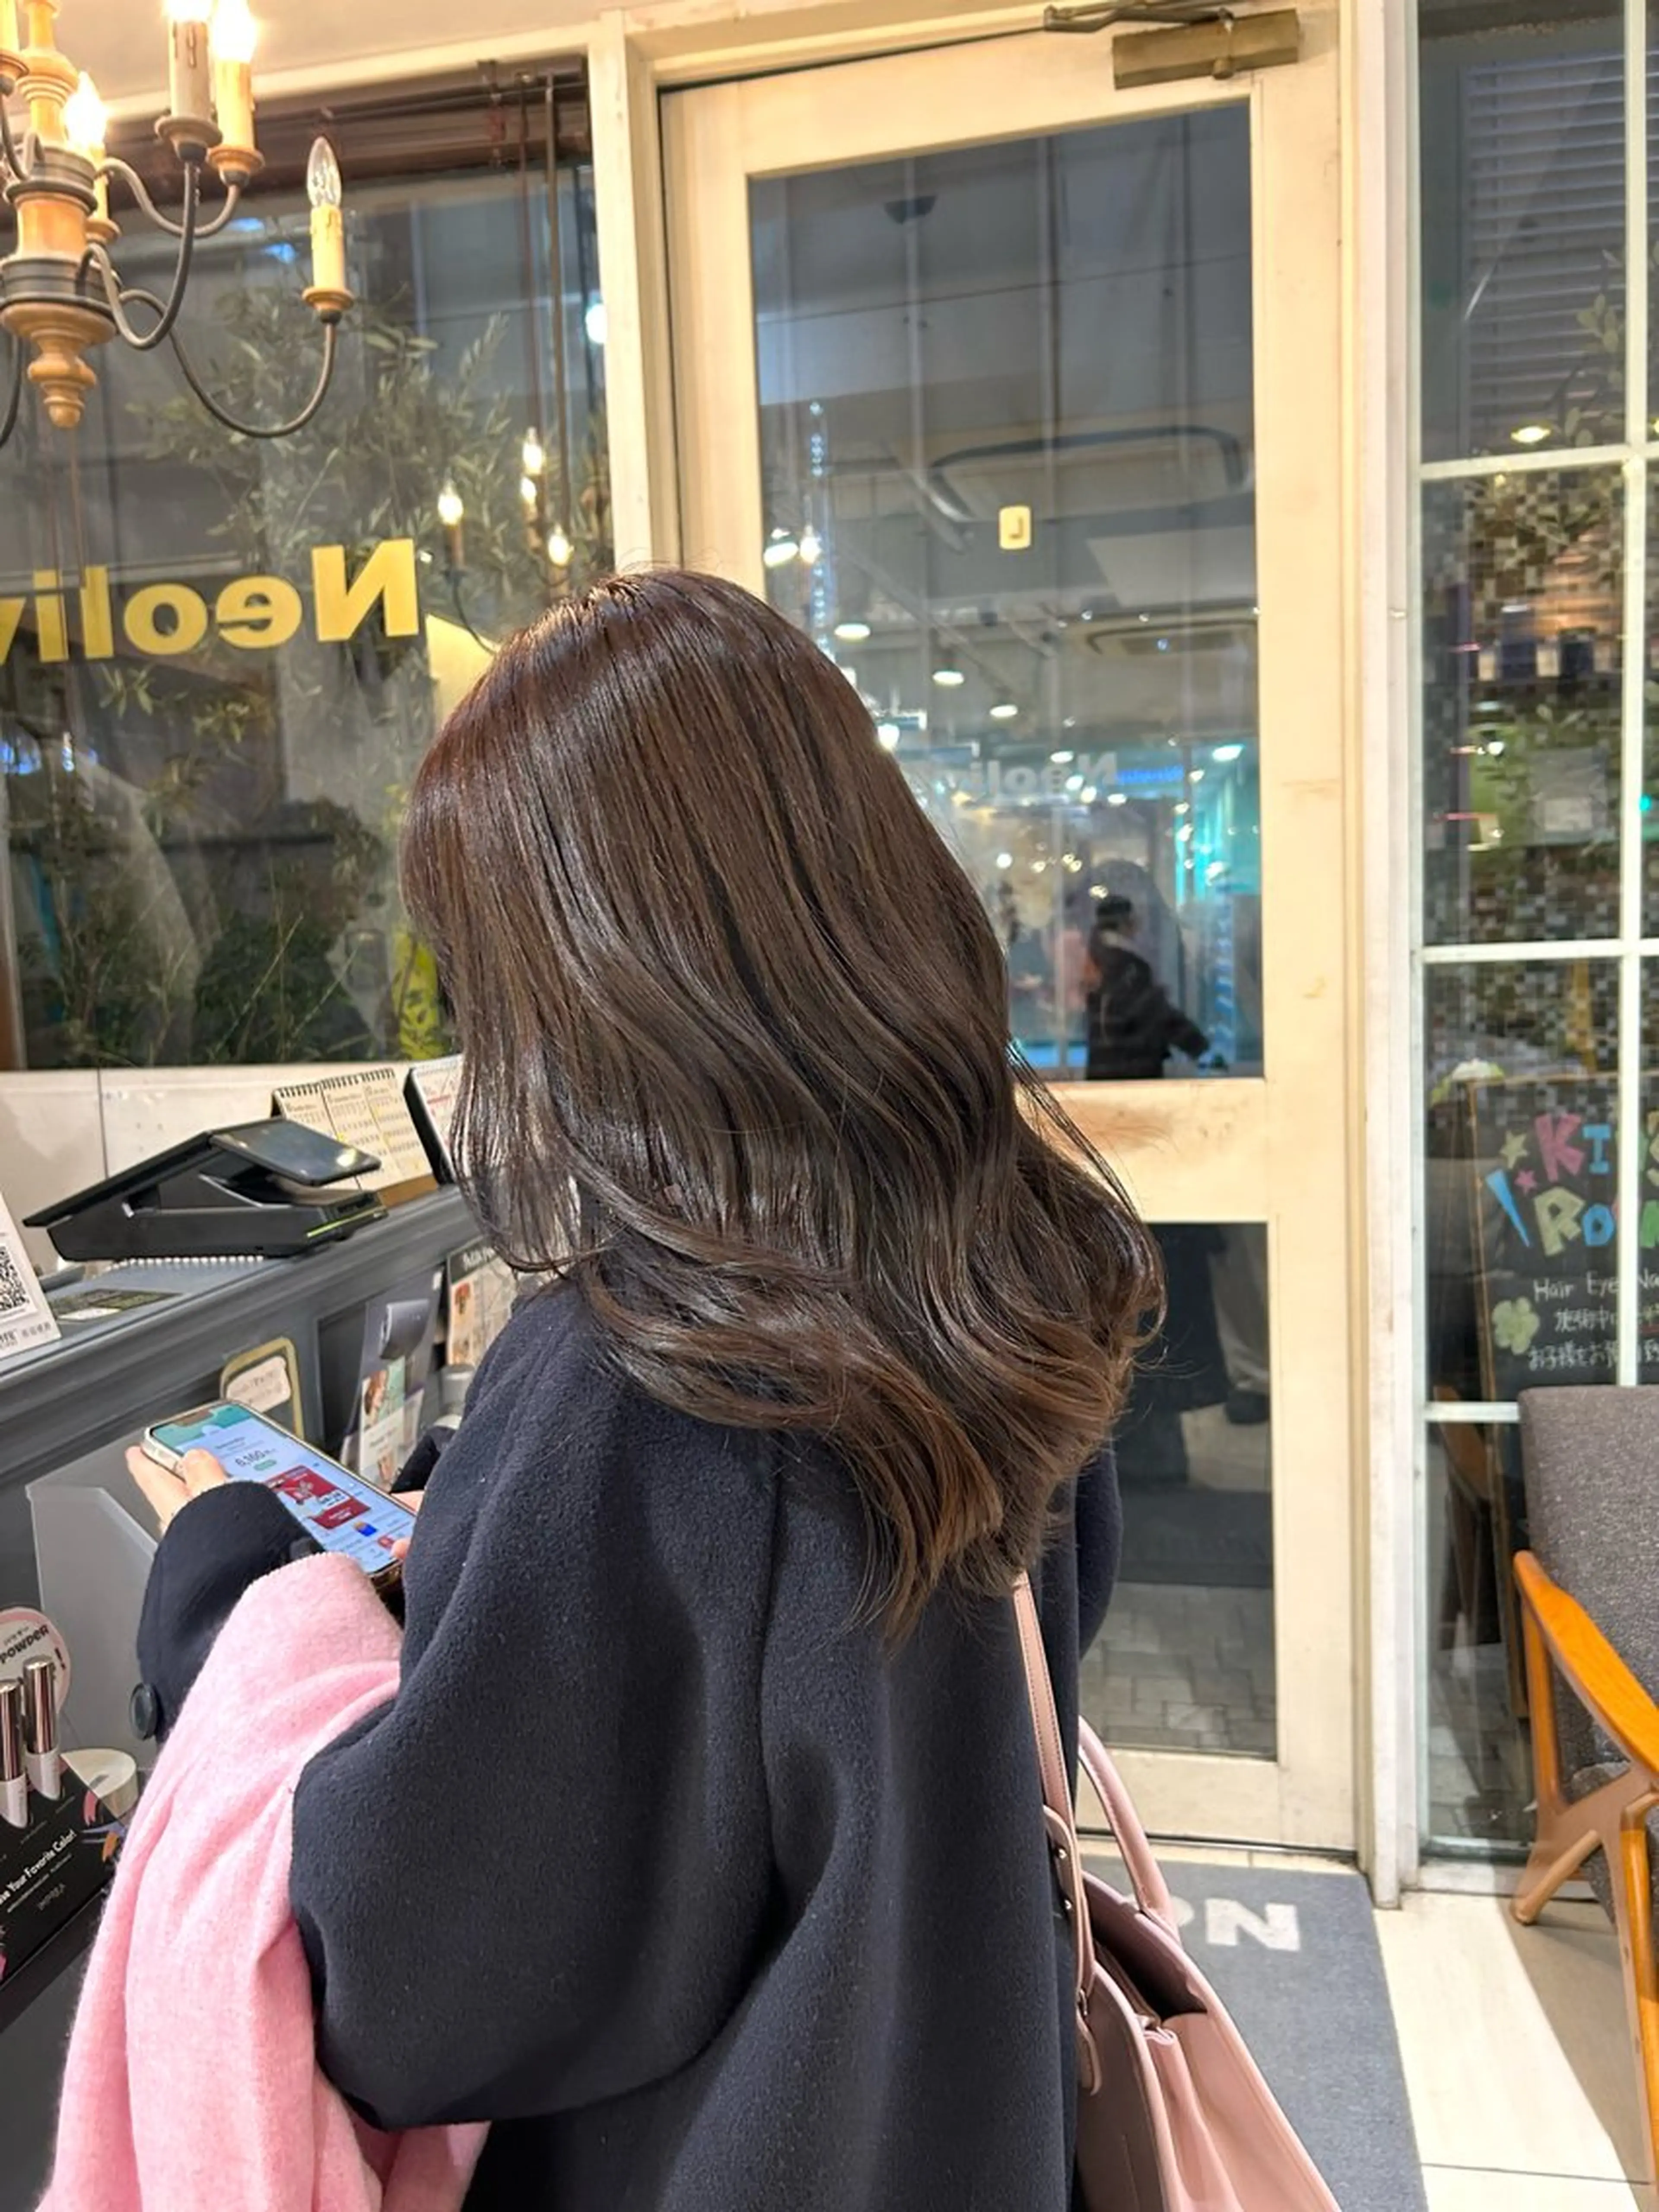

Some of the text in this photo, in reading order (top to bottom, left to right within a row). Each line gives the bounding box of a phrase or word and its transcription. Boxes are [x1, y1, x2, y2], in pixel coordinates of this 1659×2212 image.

[1533, 1278, 1574, 1303] Hair
[0, 1624, 49, 1664] POWDER
[6, 1875, 27, 1891] Your
[23, 1850, 56, 1878] Favorite
